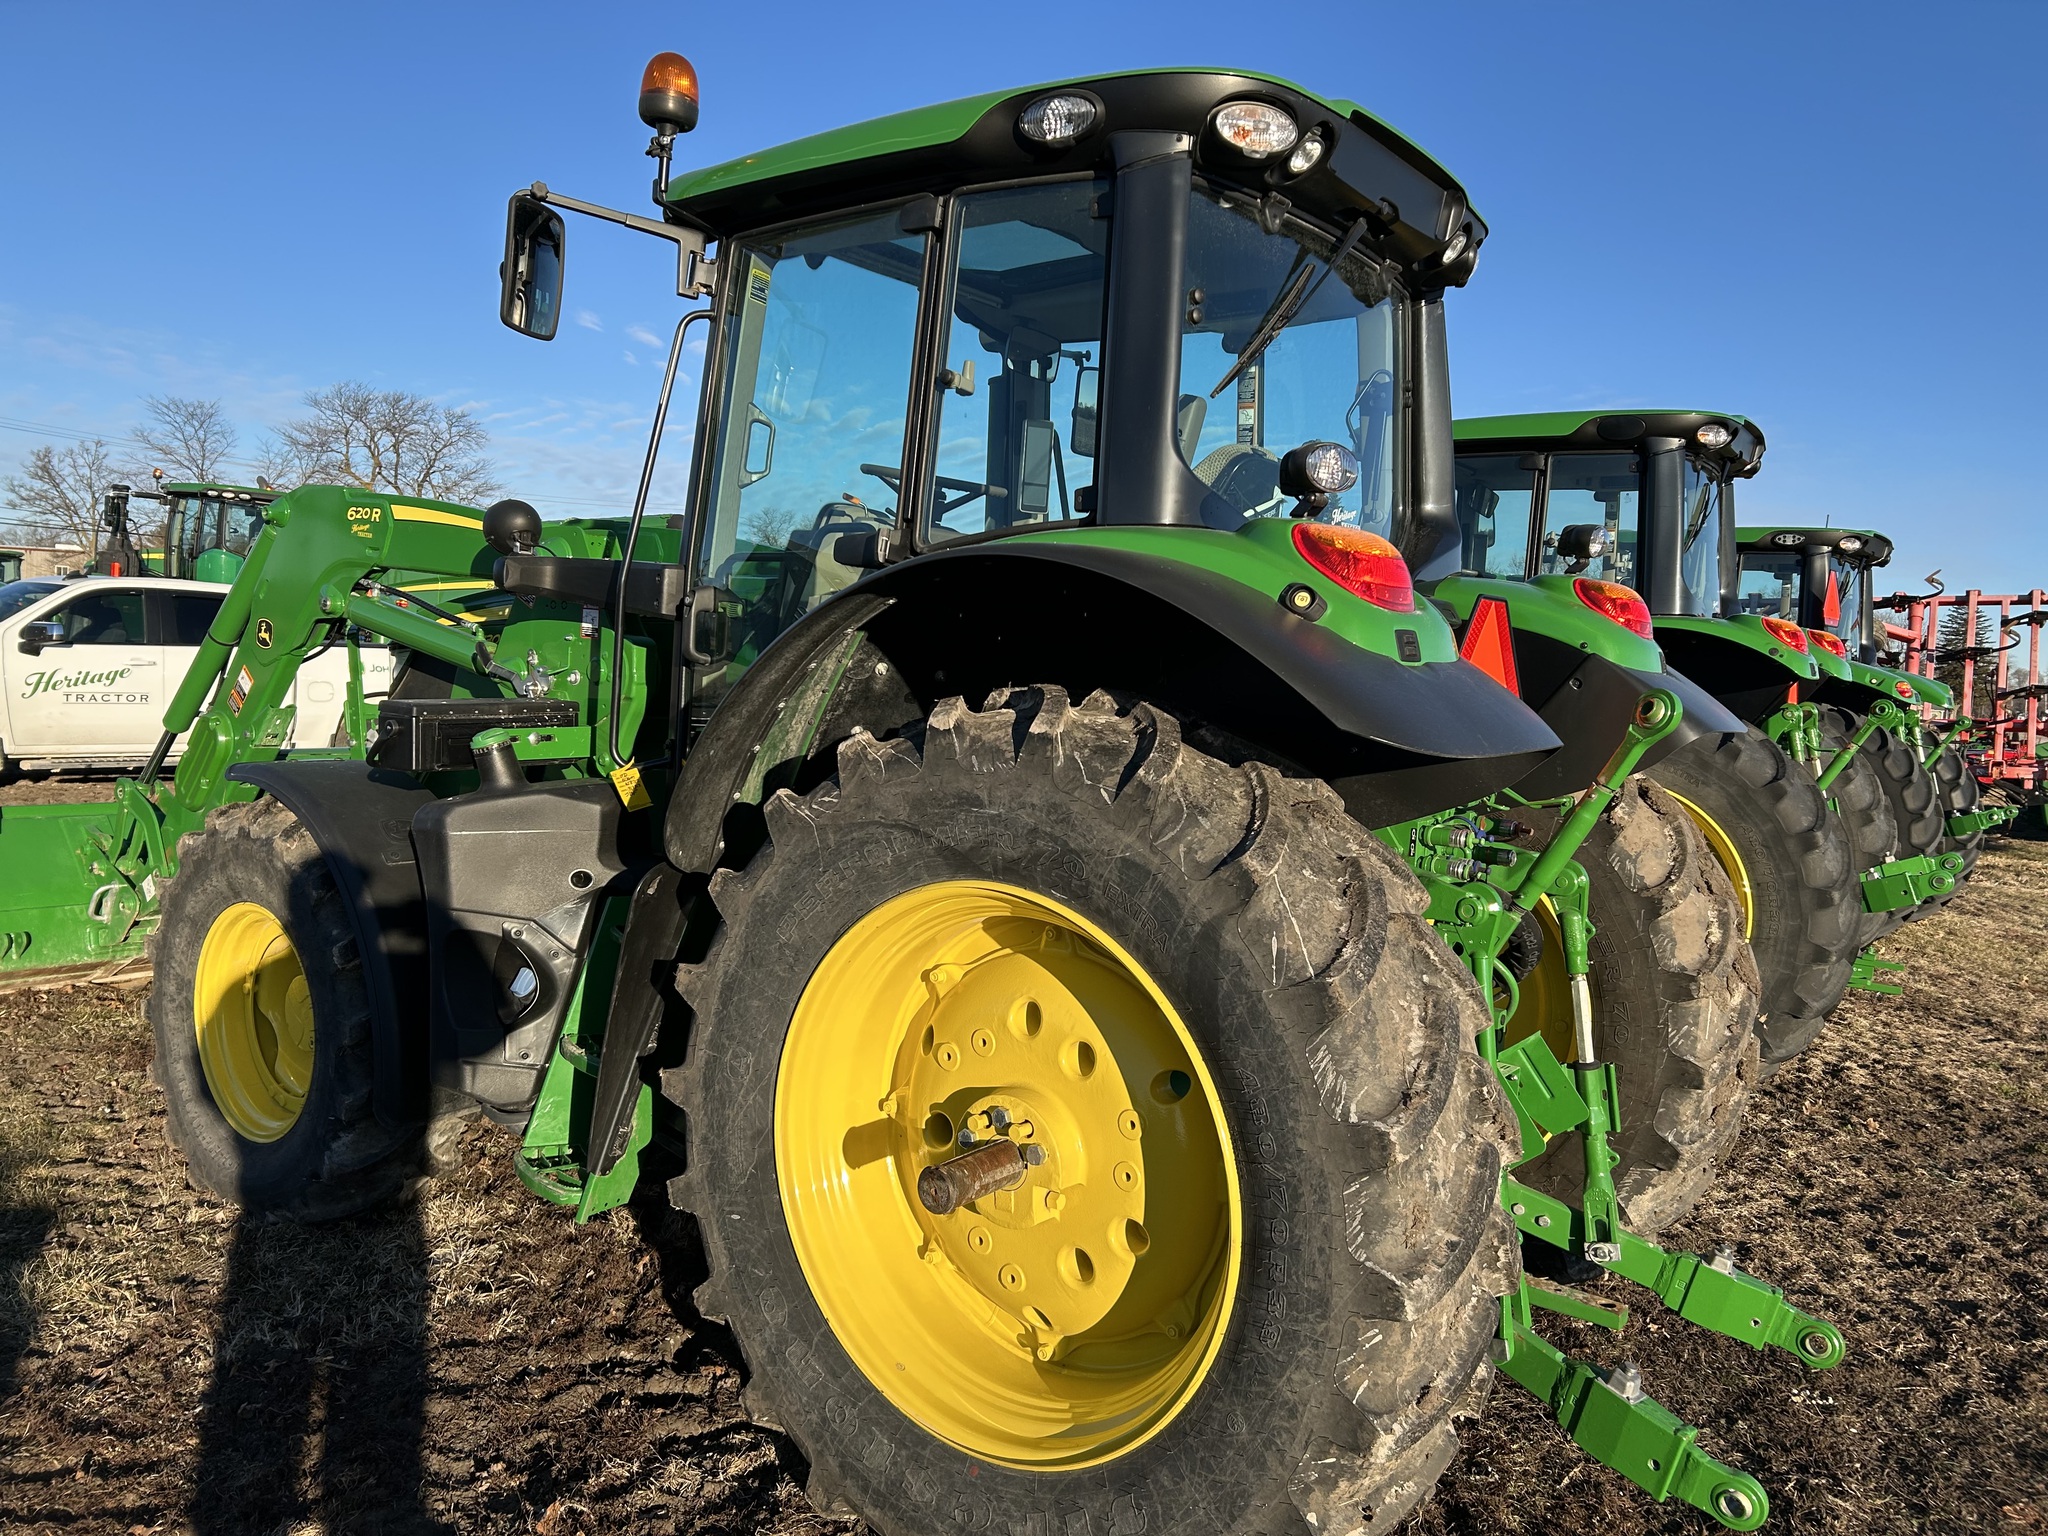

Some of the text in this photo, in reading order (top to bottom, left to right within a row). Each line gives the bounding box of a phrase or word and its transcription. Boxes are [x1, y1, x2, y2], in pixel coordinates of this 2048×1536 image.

[1331, 507, 1357, 526] Heritage
[21, 667, 132, 699] Heritage
[63, 693, 150, 703] TRACTOR
[1104, 881, 1169, 954] EXTRA
[1237, 1067, 1290, 1350] 480/70R38
